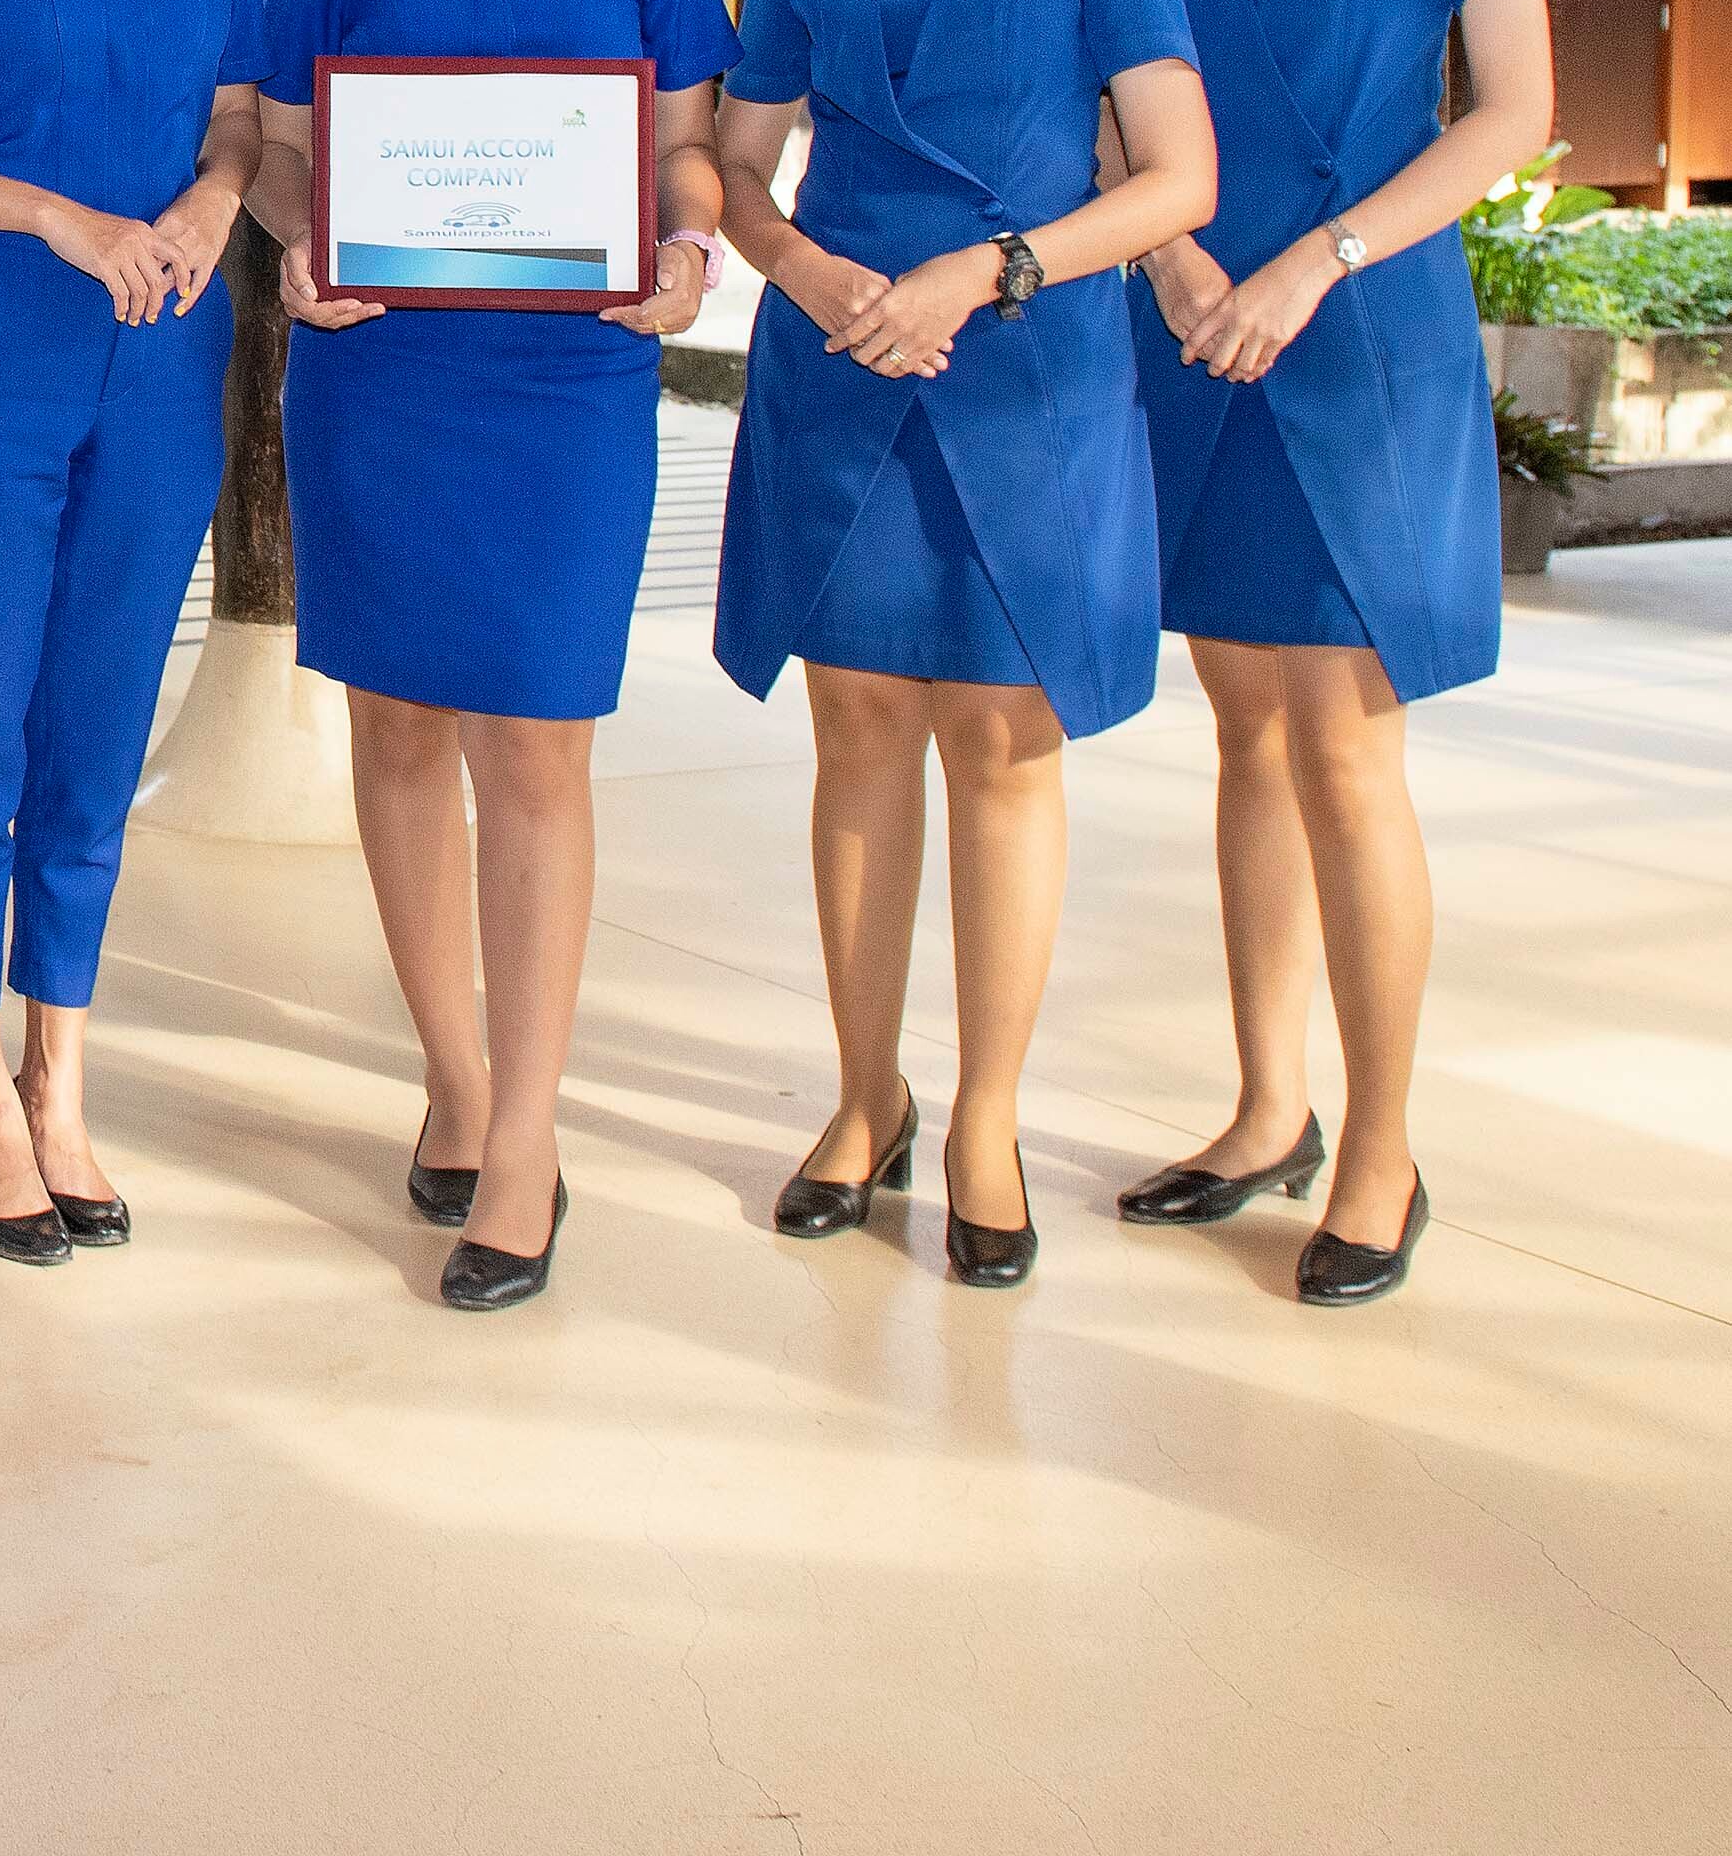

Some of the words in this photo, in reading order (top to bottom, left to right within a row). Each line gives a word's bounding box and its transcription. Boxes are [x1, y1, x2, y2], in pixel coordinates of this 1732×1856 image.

[380, 139, 455, 159] SAMUI
[463, 139, 555, 159] ACCOM
[406, 167, 529, 187] COMPANY
